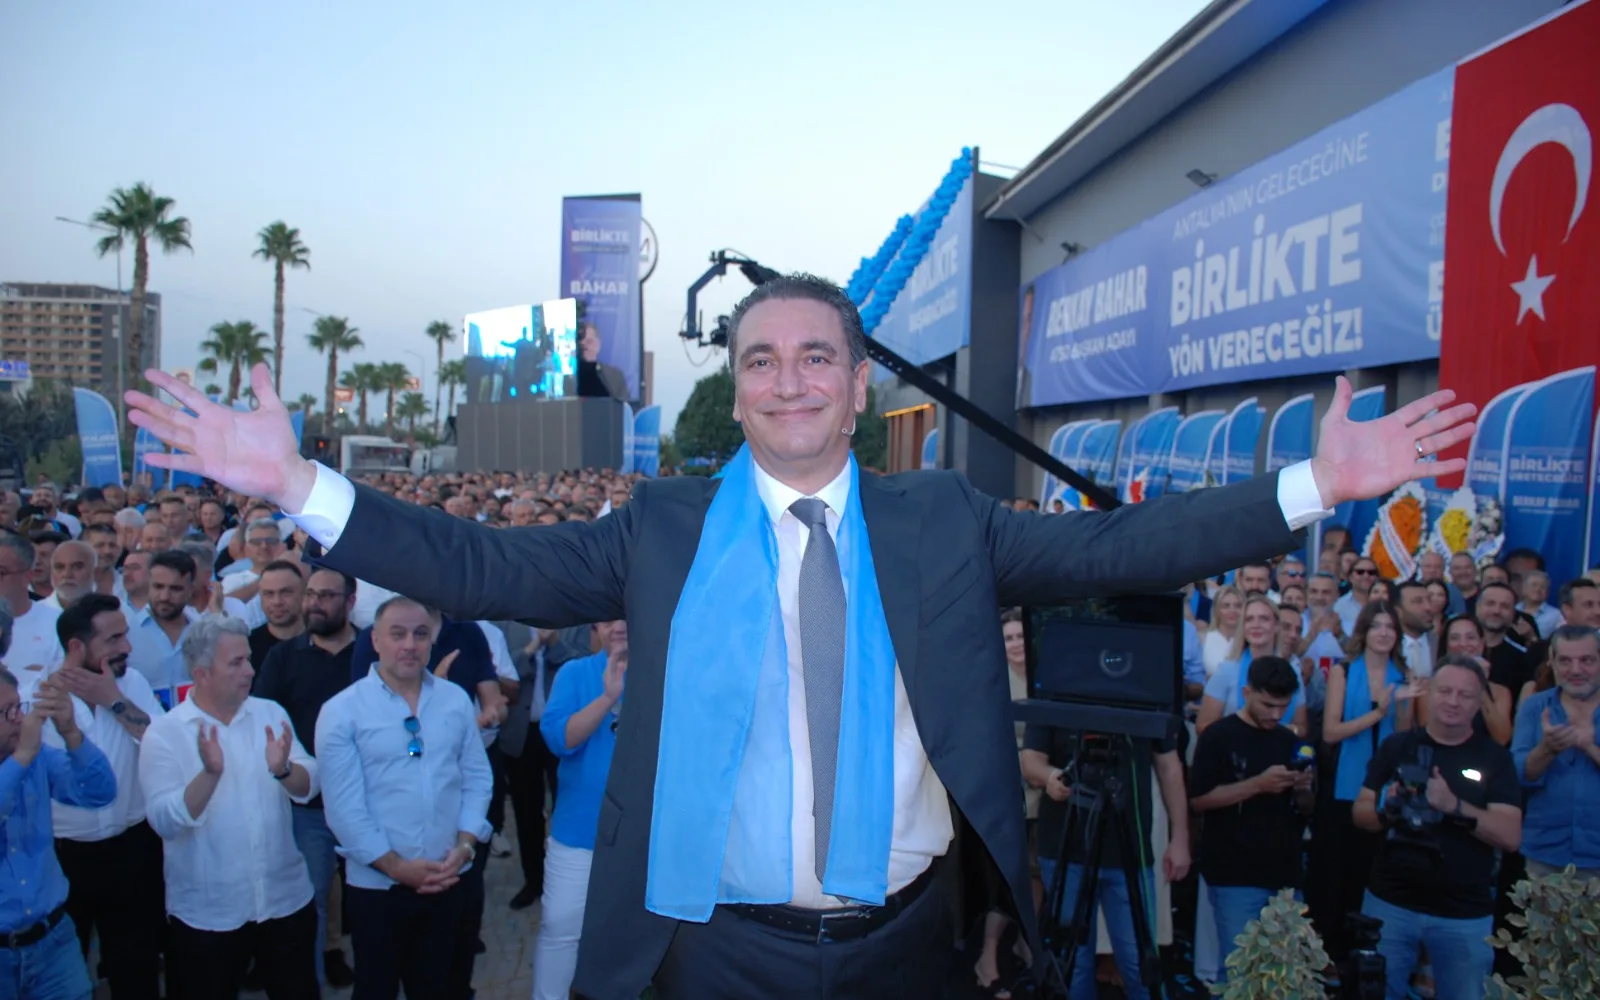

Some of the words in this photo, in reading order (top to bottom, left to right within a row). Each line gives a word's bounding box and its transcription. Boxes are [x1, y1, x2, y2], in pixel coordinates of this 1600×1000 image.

[1255, 131, 1370, 205] GELECEĞİNE
[571, 227, 630, 243] BİRLİKTE
[1170, 202, 1363, 328] BİRLİKTE
[570, 280, 629, 296] BAHAR
[1094, 264, 1148, 325] BAHAR
[1168, 332, 1205, 379] YÖN
[1208, 297, 1364, 372] VERECEĞİZ!
[1510, 453, 1585, 474] BİRLİKTE
